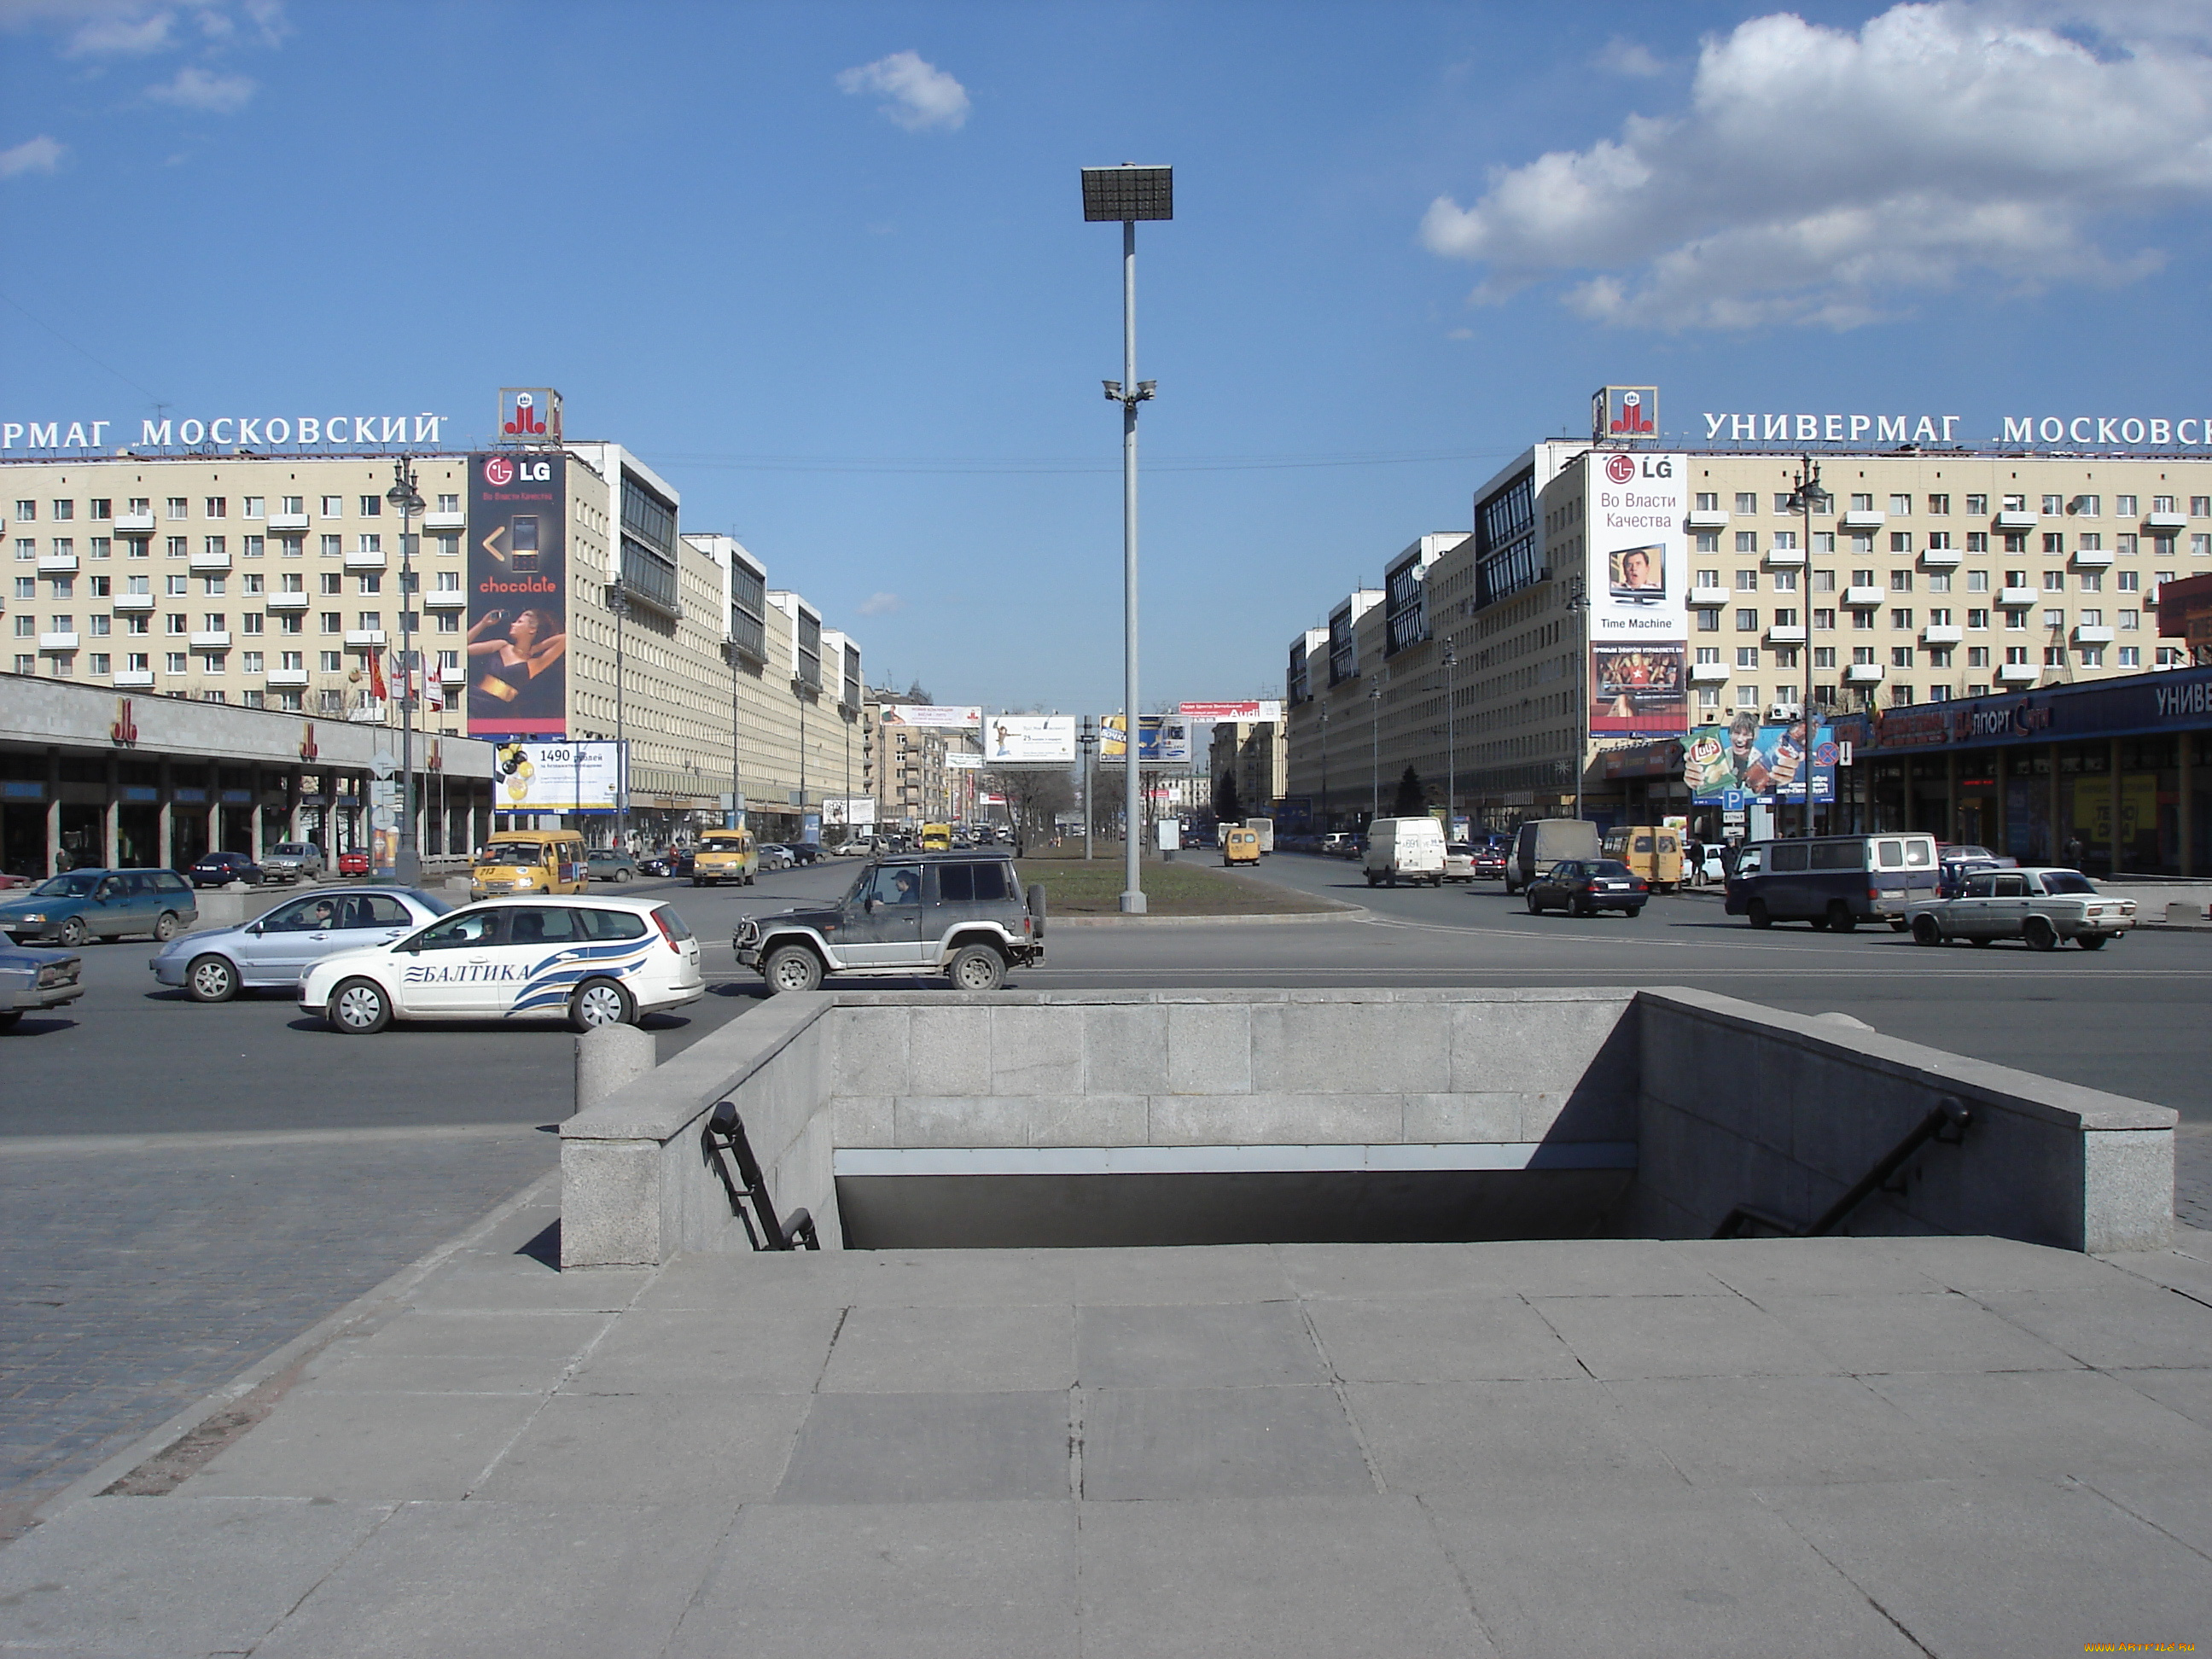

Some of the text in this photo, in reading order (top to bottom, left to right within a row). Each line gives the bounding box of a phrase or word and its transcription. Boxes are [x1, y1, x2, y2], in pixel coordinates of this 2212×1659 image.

[1703, 412, 1960, 441] УНИВЕРМАГ
[3, 421, 111, 449] РМАГ
[519, 462, 550, 481] LG
[1642, 461, 1673, 479] LG
[1601, 492, 1676, 508] Во Власти
[1607, 513, 1672, 527] Качества
[480, 576, 556, 592] chocolate
[1601, 619, 1673, 628] Time Machine
[1230, 709, 1259, 718] Audi
[540, 749, 570, 761] 1490
[423, 964, 531, 982] БАЛТИКА
